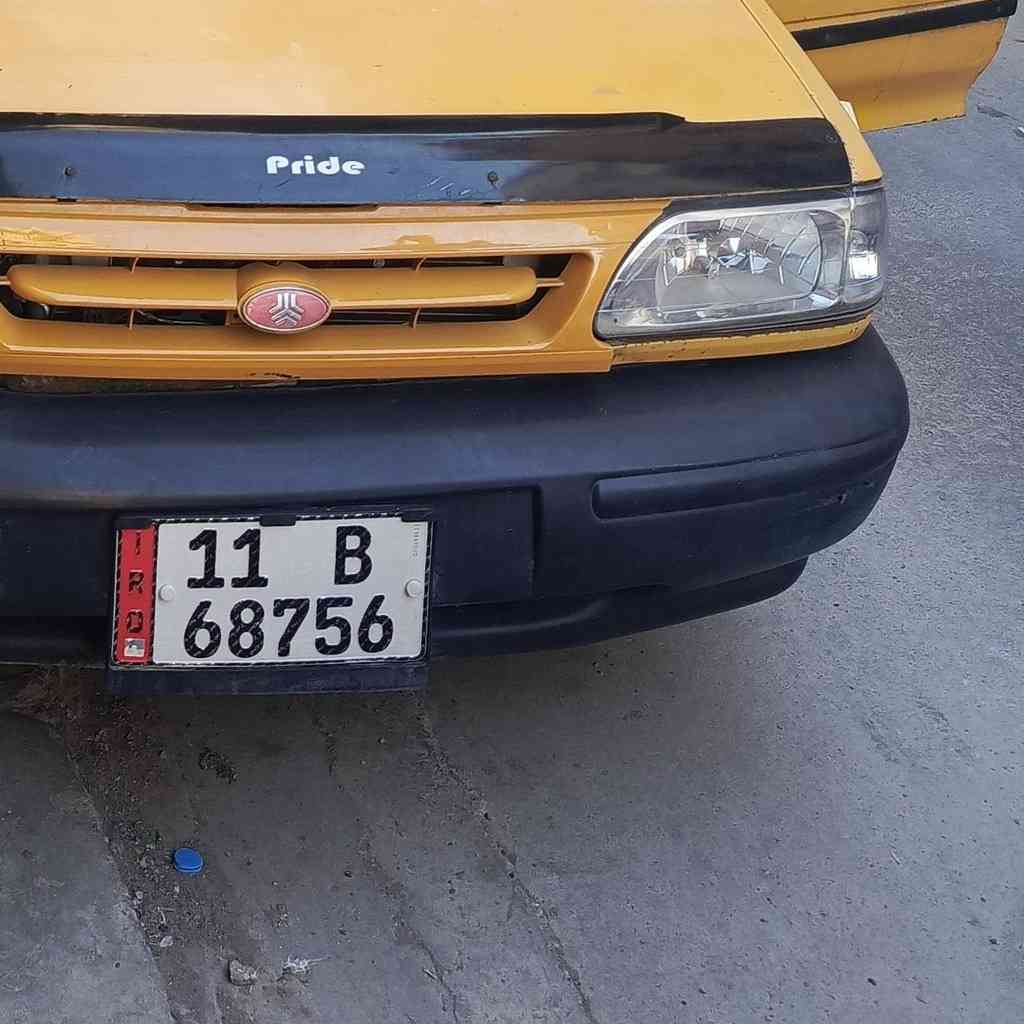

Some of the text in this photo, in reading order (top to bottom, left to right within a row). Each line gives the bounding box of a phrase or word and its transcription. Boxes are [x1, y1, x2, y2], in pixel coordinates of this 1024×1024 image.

[266, 155, 365, 175] Pride
[187, 528, 269, 589] 11
[333, 525, 373, 586] B
[183, 595, 394, 659] 68756
